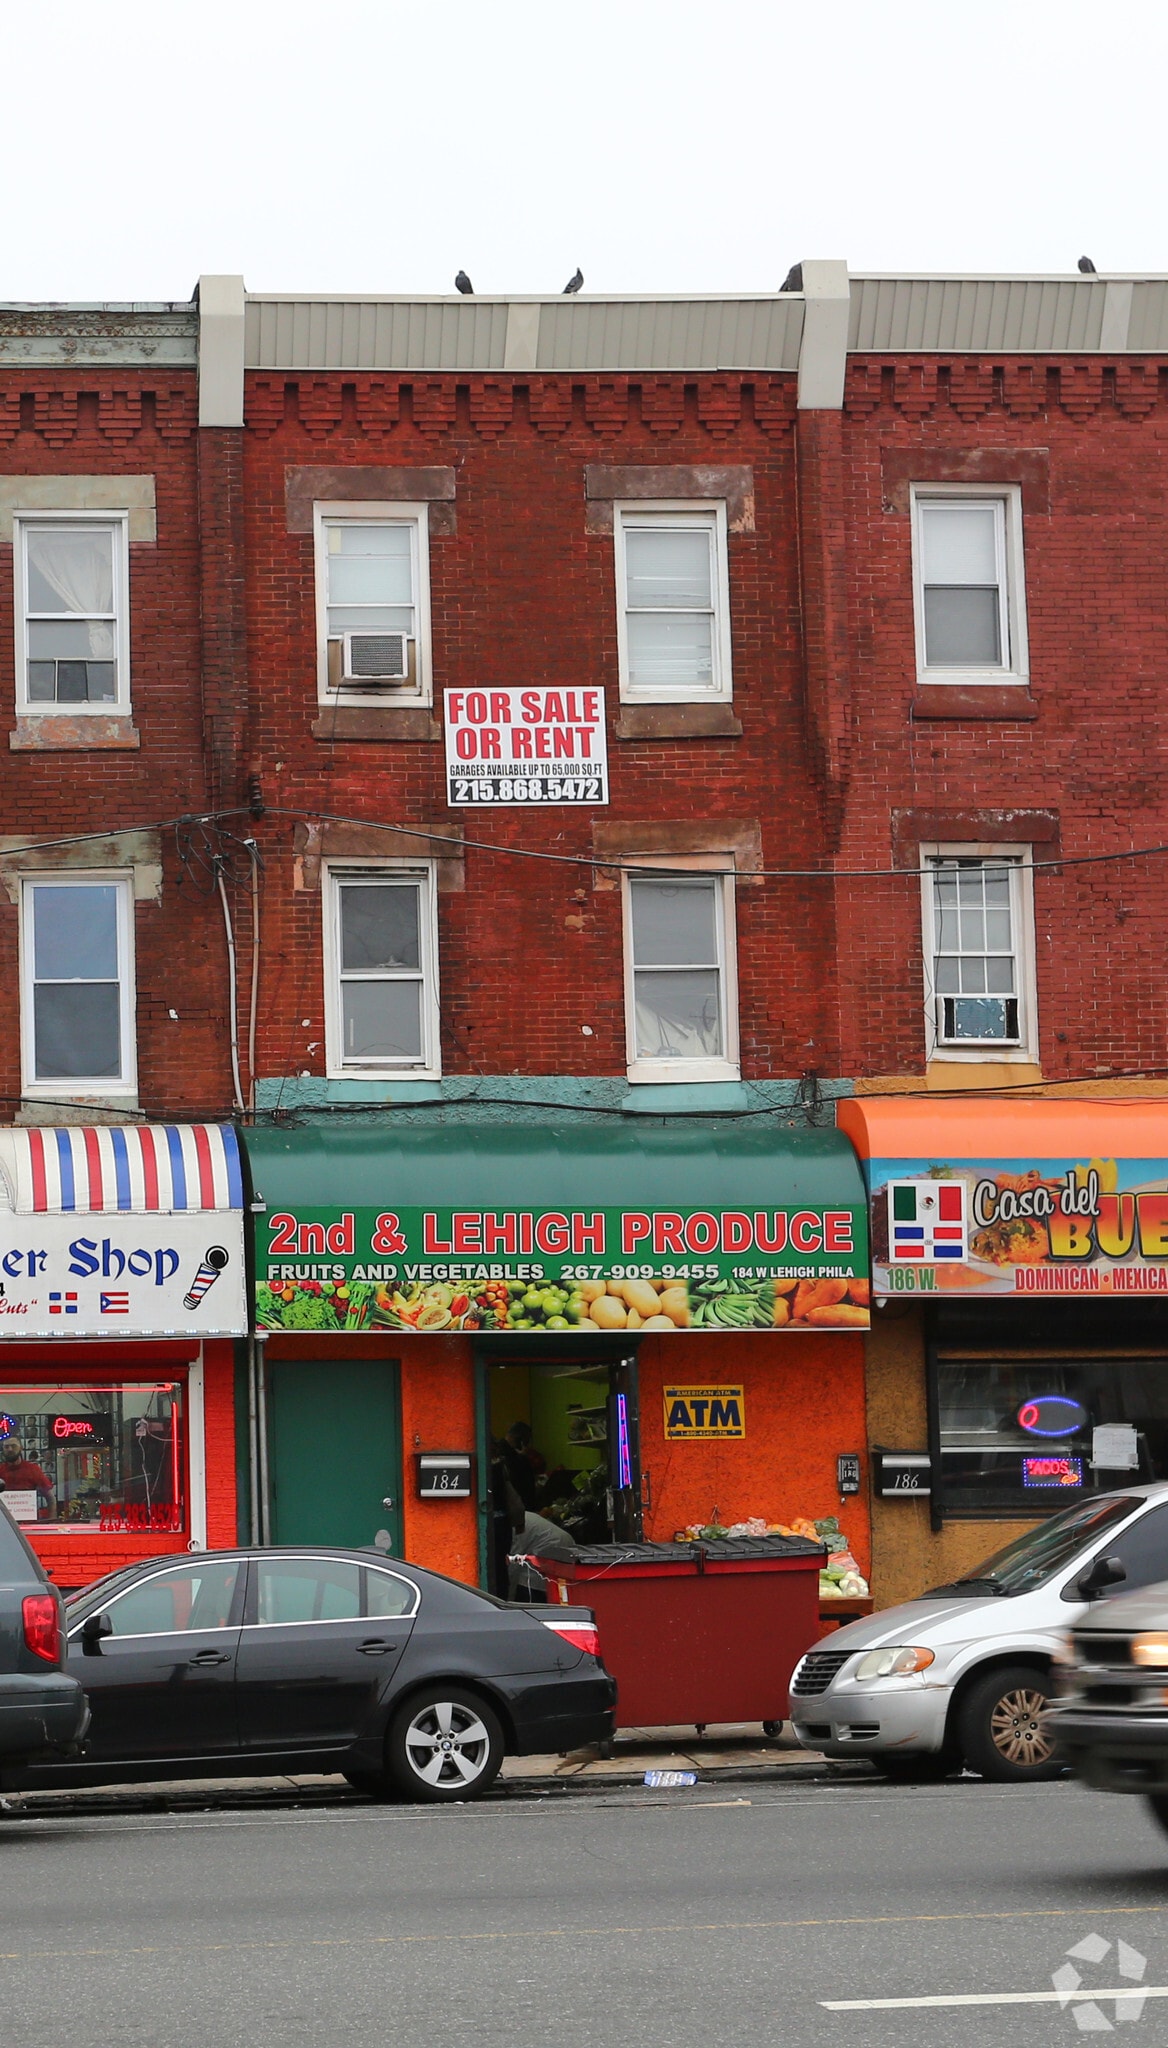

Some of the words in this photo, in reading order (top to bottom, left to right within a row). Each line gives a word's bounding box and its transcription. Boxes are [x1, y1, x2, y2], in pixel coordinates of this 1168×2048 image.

[449, 692, 511, 724] FOR
[520, 691, 600, 724] SALE
[456, 727, 501, 760] OR
[511, 727, 595, 759] RENT
[449, 764, 486, 776] GARAGES
[487, 764, 527, 776] AVAILABLE
[528, 764, 539, 775] UP
[541, 764, 551, 775] TO
[552, 764, 580, 776] 65,000
[581, 763, 603, 776] SQ.FT
[455, 778, 600, 801] 215.868.5472
[973, 1178, 1055, 1227] Casa
[1060, 1169, 1100, 1216] del
[268, 1213, 354, 1255] 2nd
[371, 1213, 408, 1255] &
[423, 1212, 605, 1255] LEHIGH
[622, 1211, 853, 1254] PRODUCE
[68, 1237, 180, 1286] Shop
[267, 1264, 346, 1281] FRUITS
[352, 1264, 397, 1280] AND
[404, 1264, 544, 1280] VEGETABLES
[560, 1264, 719, 1280] 267-909-9455
[732, 1267, 753, 1279] 184
[756, 1267, 767, 1279] W
[770, 1267, 815, 1279] LEHIGH
[818, 1267, 854, 1279] PHILA
[887, 1268, 914, 1291] 186
[918, 1269, 938, 1291] W.
[1015, 1268, 1099, 1290] DOMINICAN
[1112, 1268, 1168, 1290] MEXICA
[667, 1400, 741, 1427] ATM
[54, 1417, 93, 1437] Open
[1027, 1461, 1070, 1475] TACOS
[432, 1474, 460, 1490] 184
[894, 1474, 919, 1489] 186
